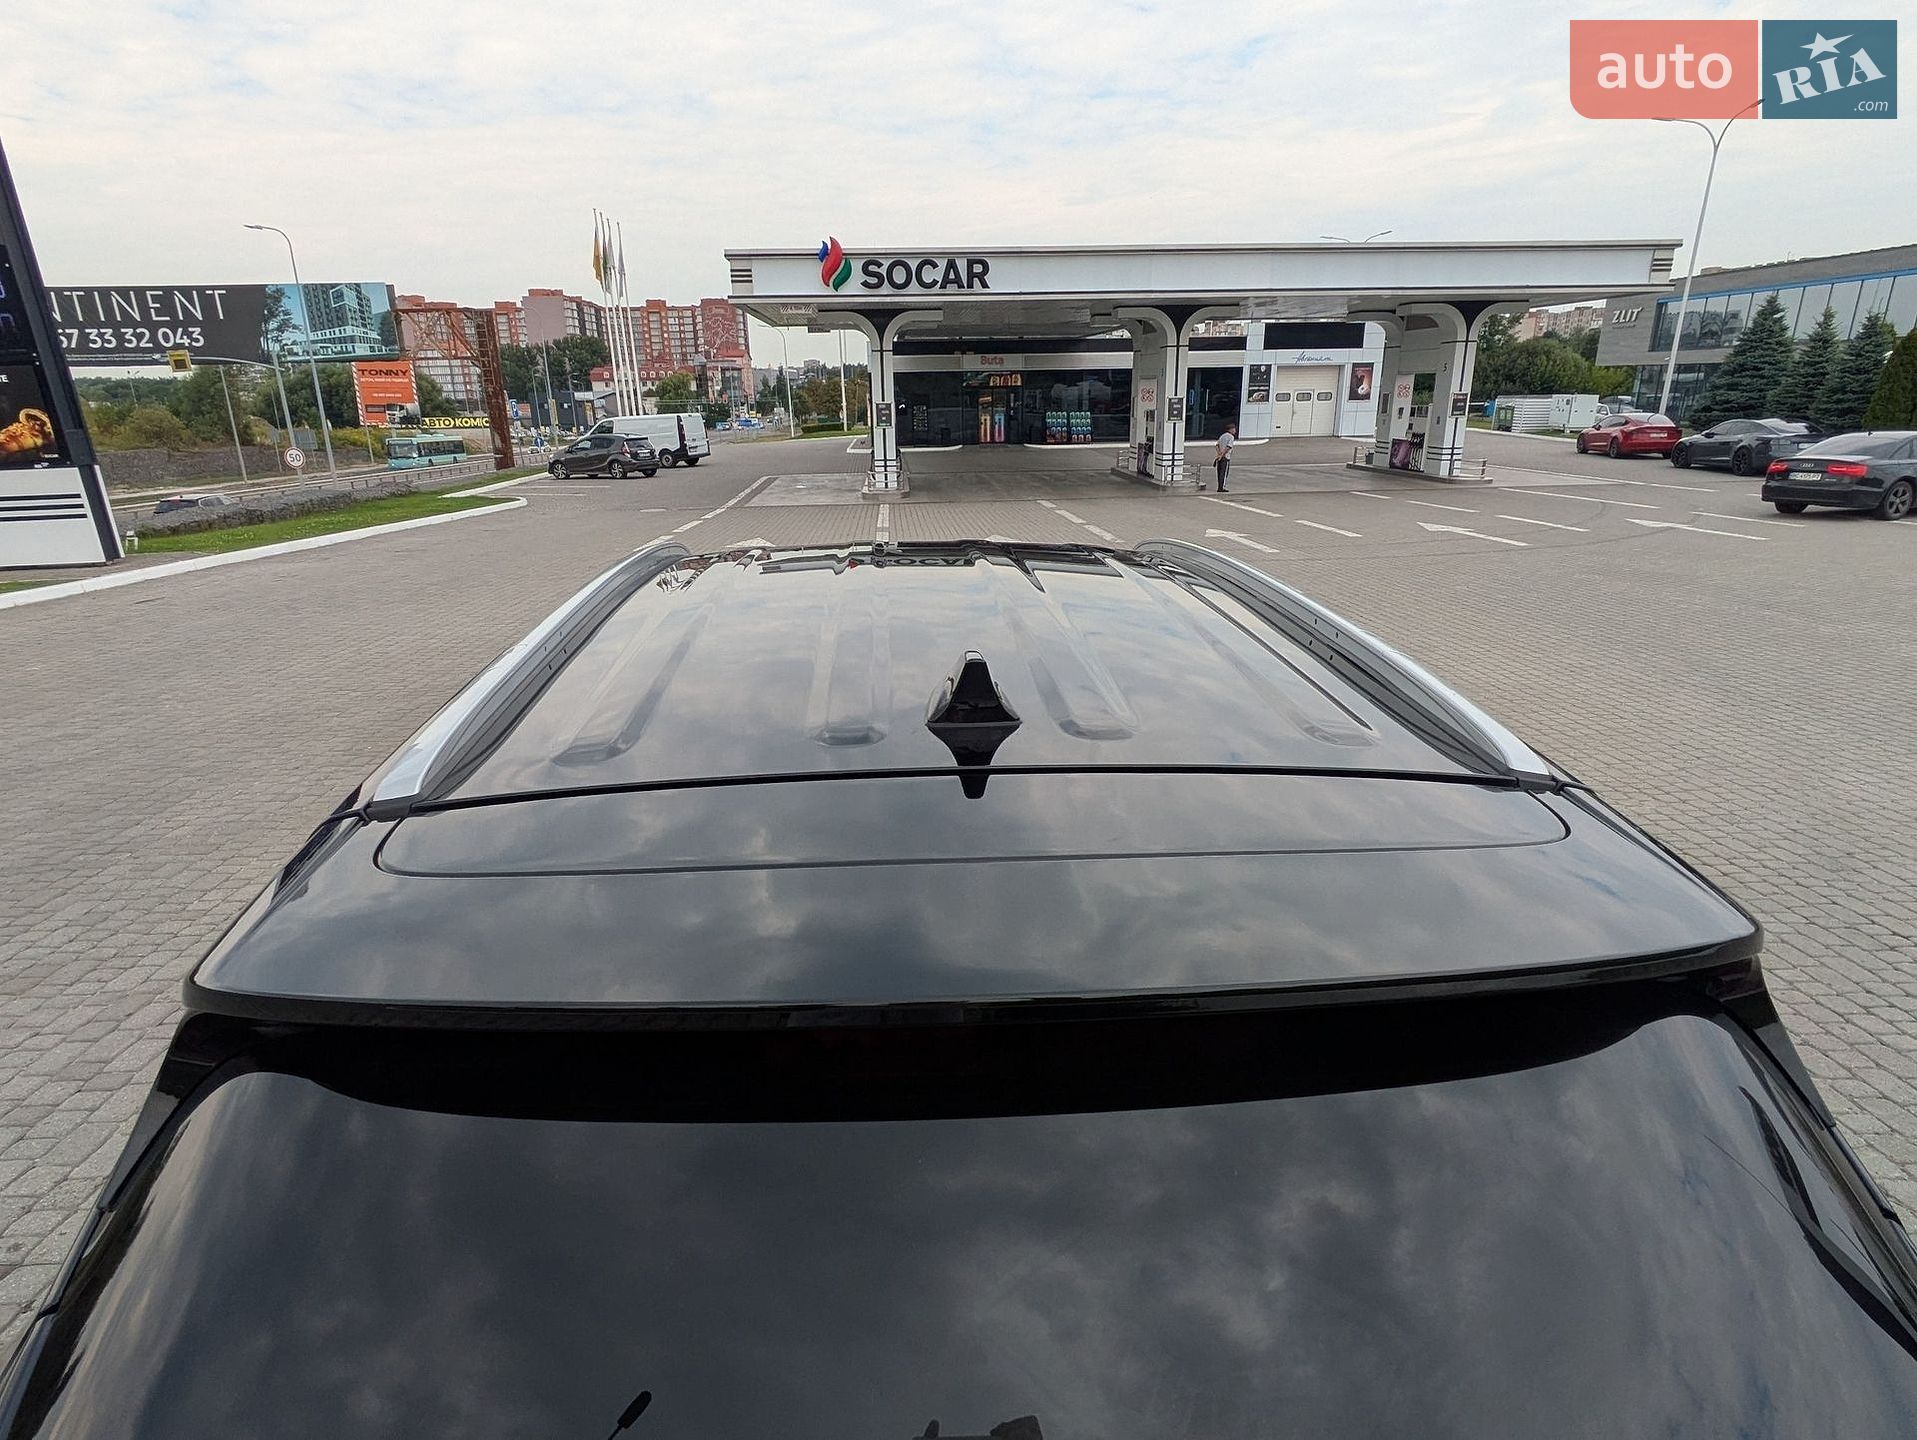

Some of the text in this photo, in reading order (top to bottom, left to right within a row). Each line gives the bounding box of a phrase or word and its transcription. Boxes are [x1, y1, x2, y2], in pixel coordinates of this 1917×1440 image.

[860, 258, 991, 290] SOCAR
[85, 328, 117, 348] 33
[120, 328, 153, 348] 32
[157, 327, 205, 347] 043
[358, 369, 409, 377] TONNY
[288, 453, 301, 462] 50
